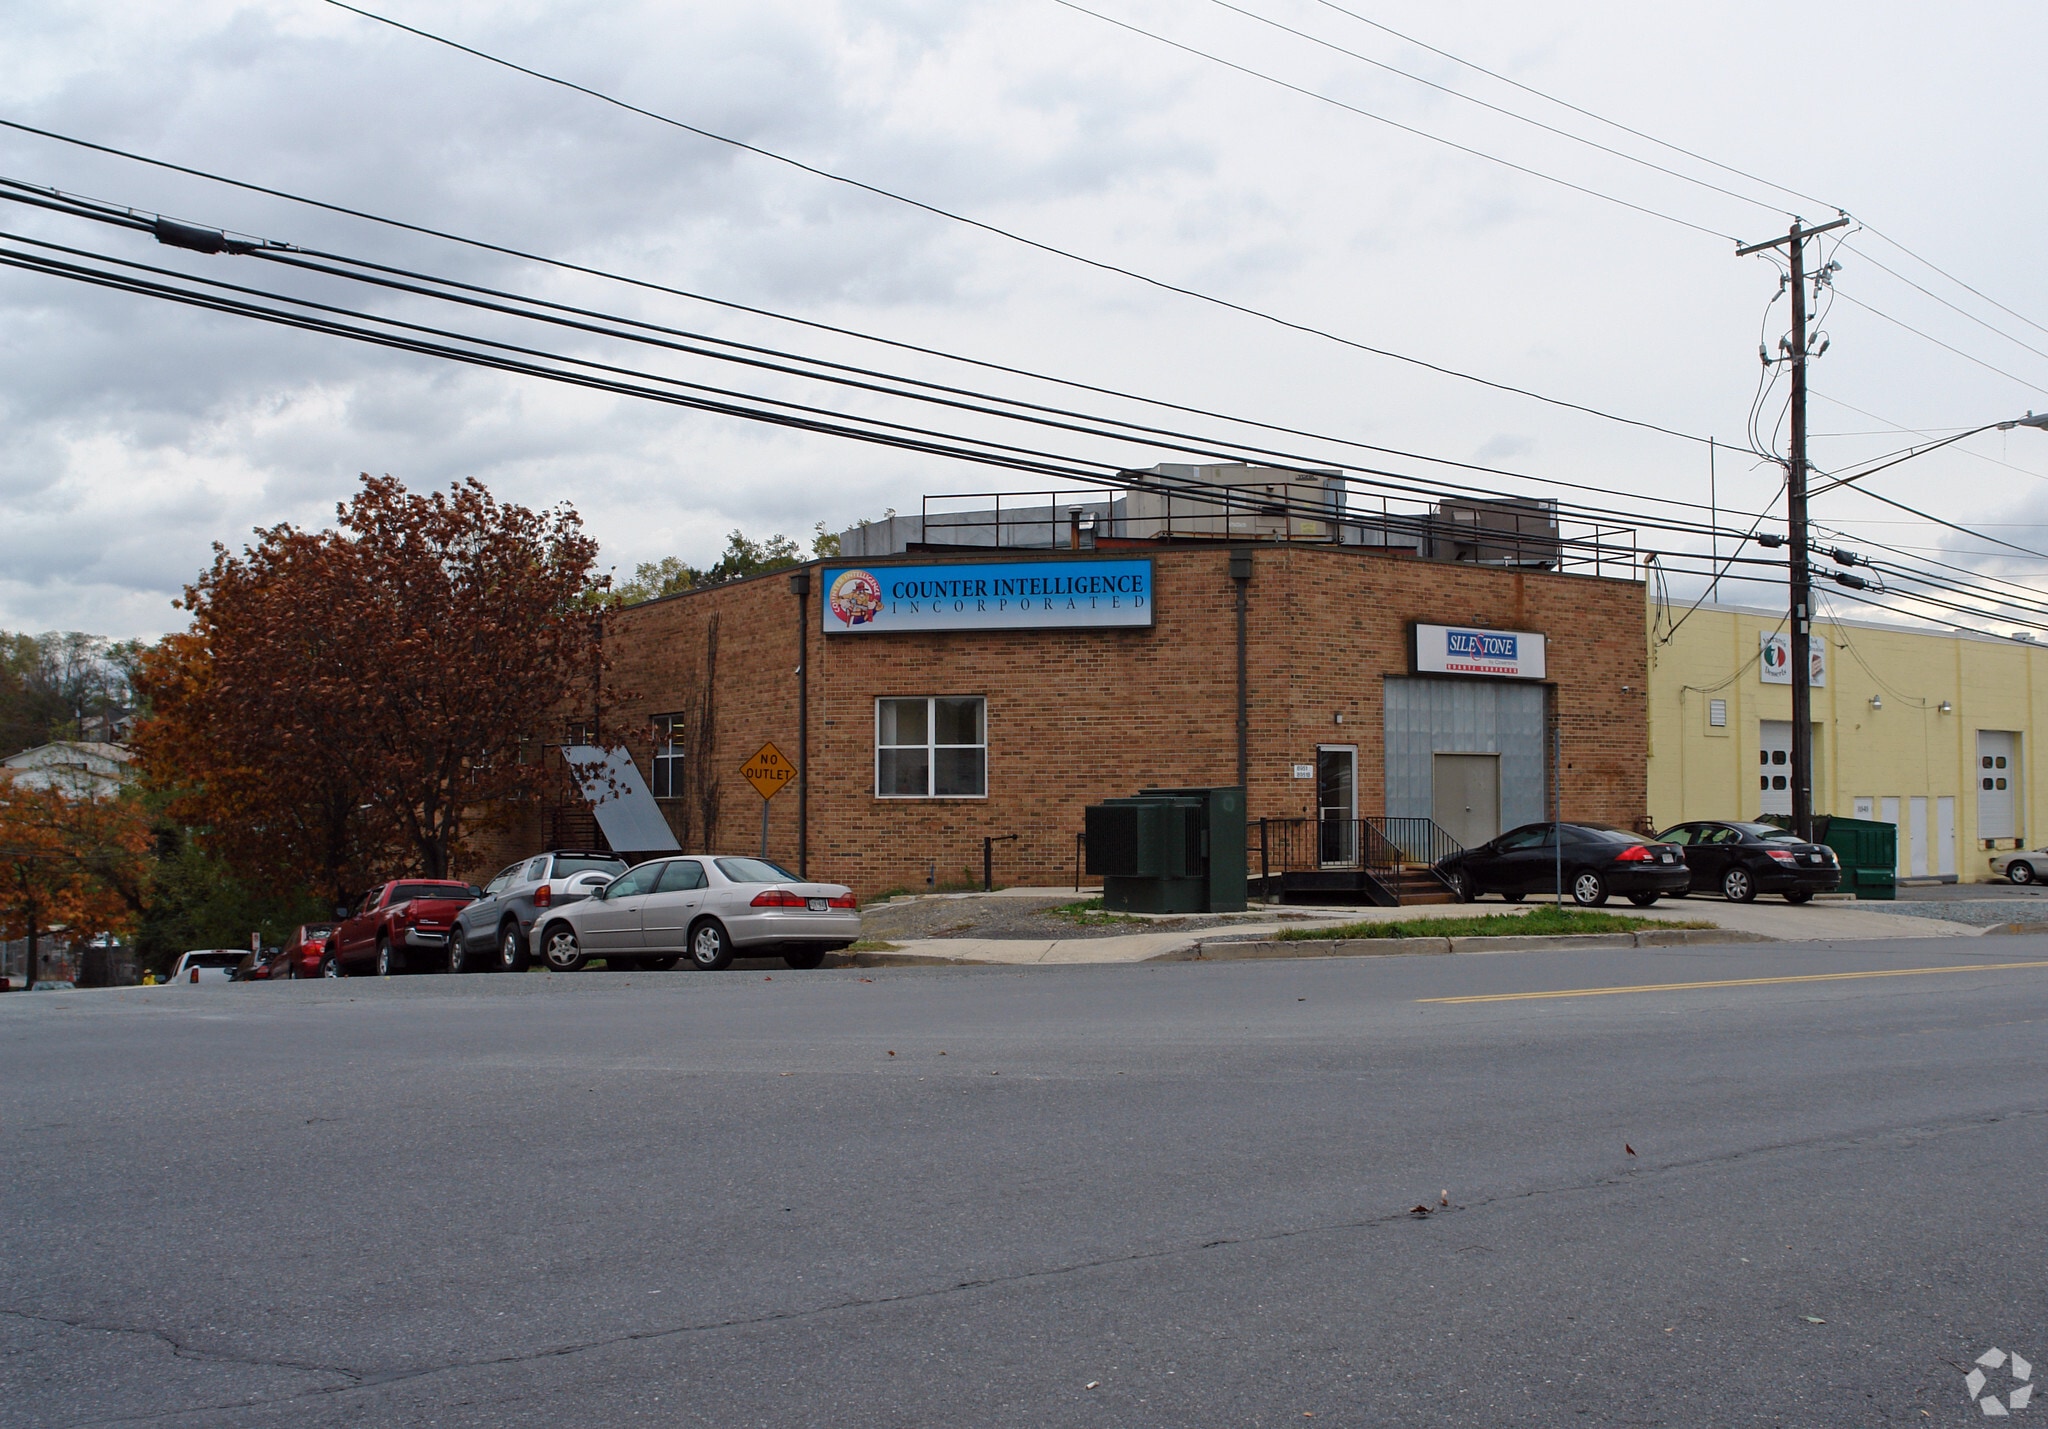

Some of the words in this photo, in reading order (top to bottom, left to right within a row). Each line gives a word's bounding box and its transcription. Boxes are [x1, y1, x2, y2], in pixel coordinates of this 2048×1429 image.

[892, 578, 988, 599] COUNTER
[993, 574, 1144, 596] INTELLIGENCE
[892, 595, 1145, 614] INCORPORATED
[1449, 633, 1514, 661] SILESTONE
[761, 754, 778, 765] NO
[746, 768, 790, 780] OUTLET
